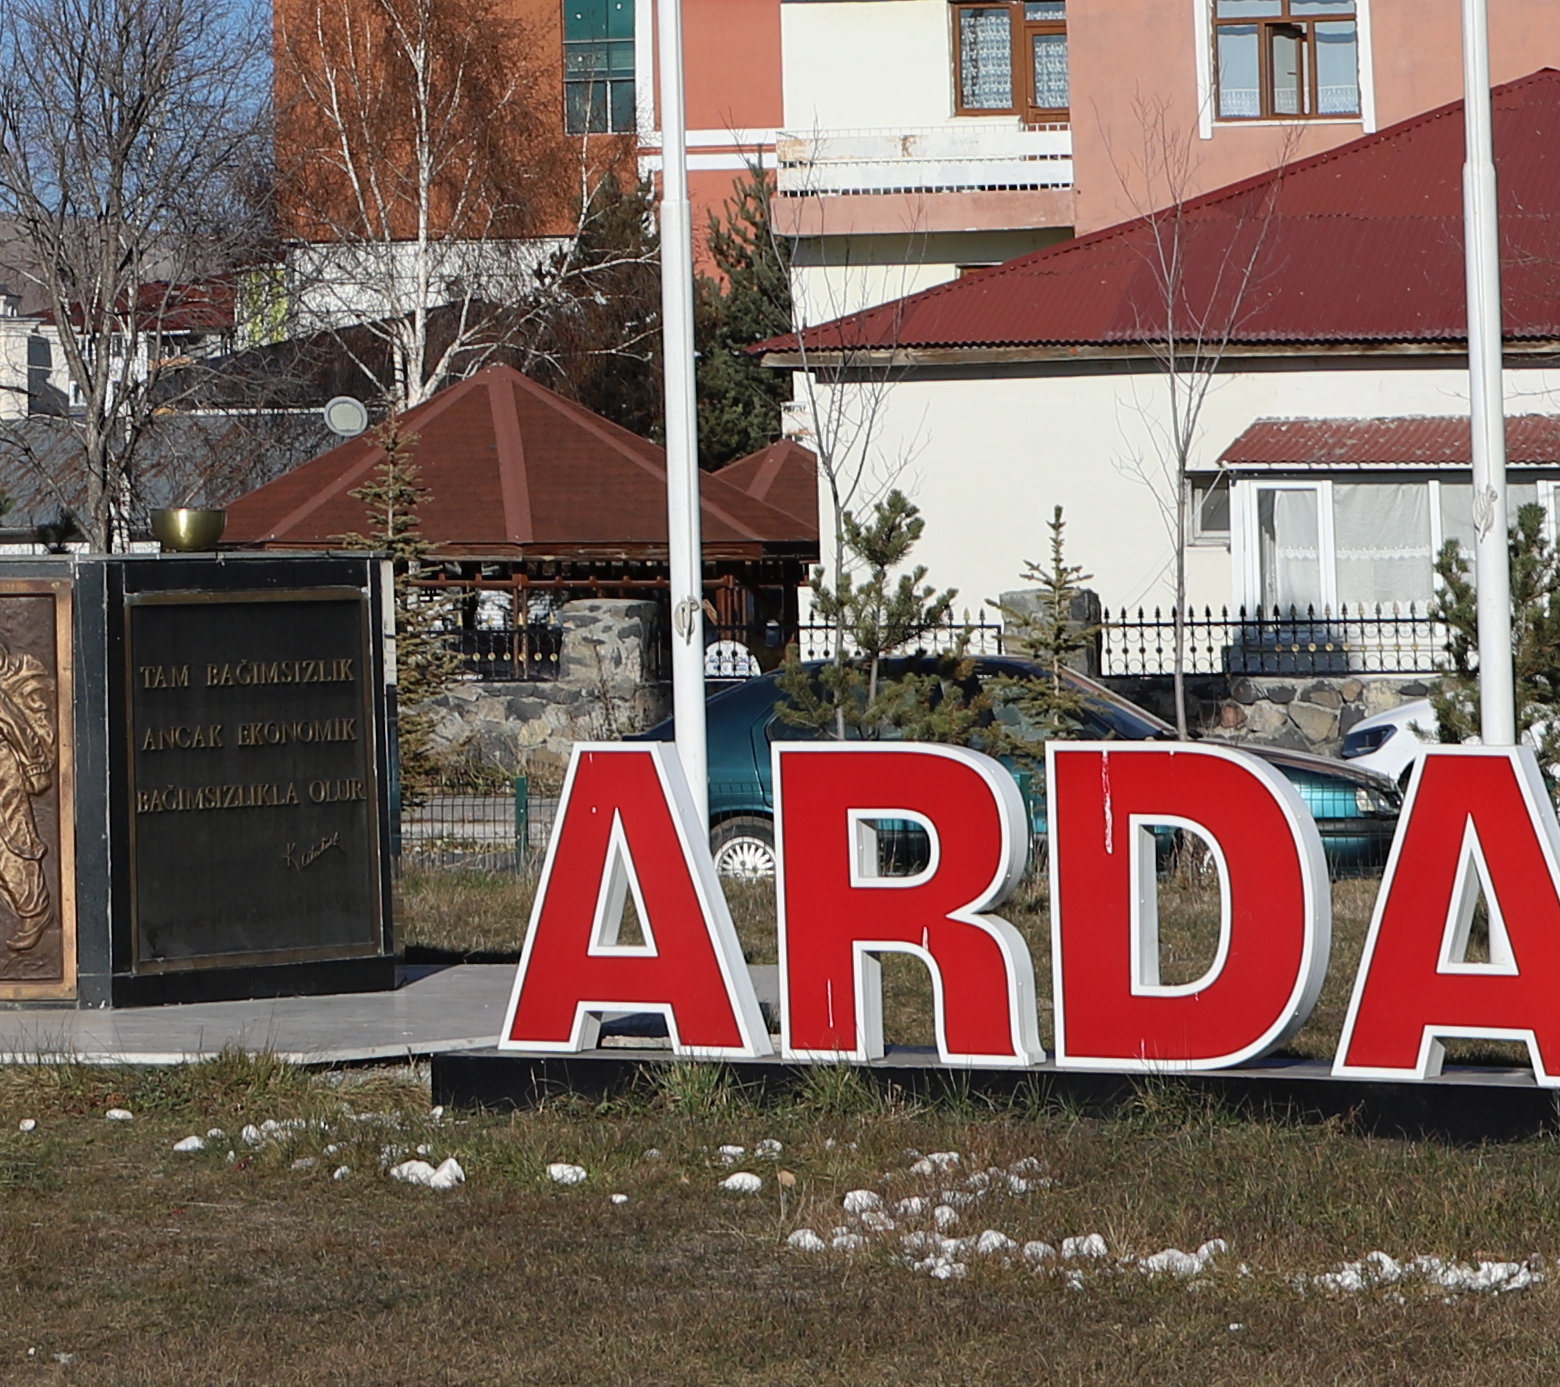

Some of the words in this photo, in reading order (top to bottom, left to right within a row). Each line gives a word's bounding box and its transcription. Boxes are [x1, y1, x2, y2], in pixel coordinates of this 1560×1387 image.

[140, 664, 190, 689] TAM
[206, 658, 355, 687] BAĞIMSIZLIK
[141, 725, 224, 751] ANCAK
[136, 783, 301, 813] BAĞIMSIZLIKLA
